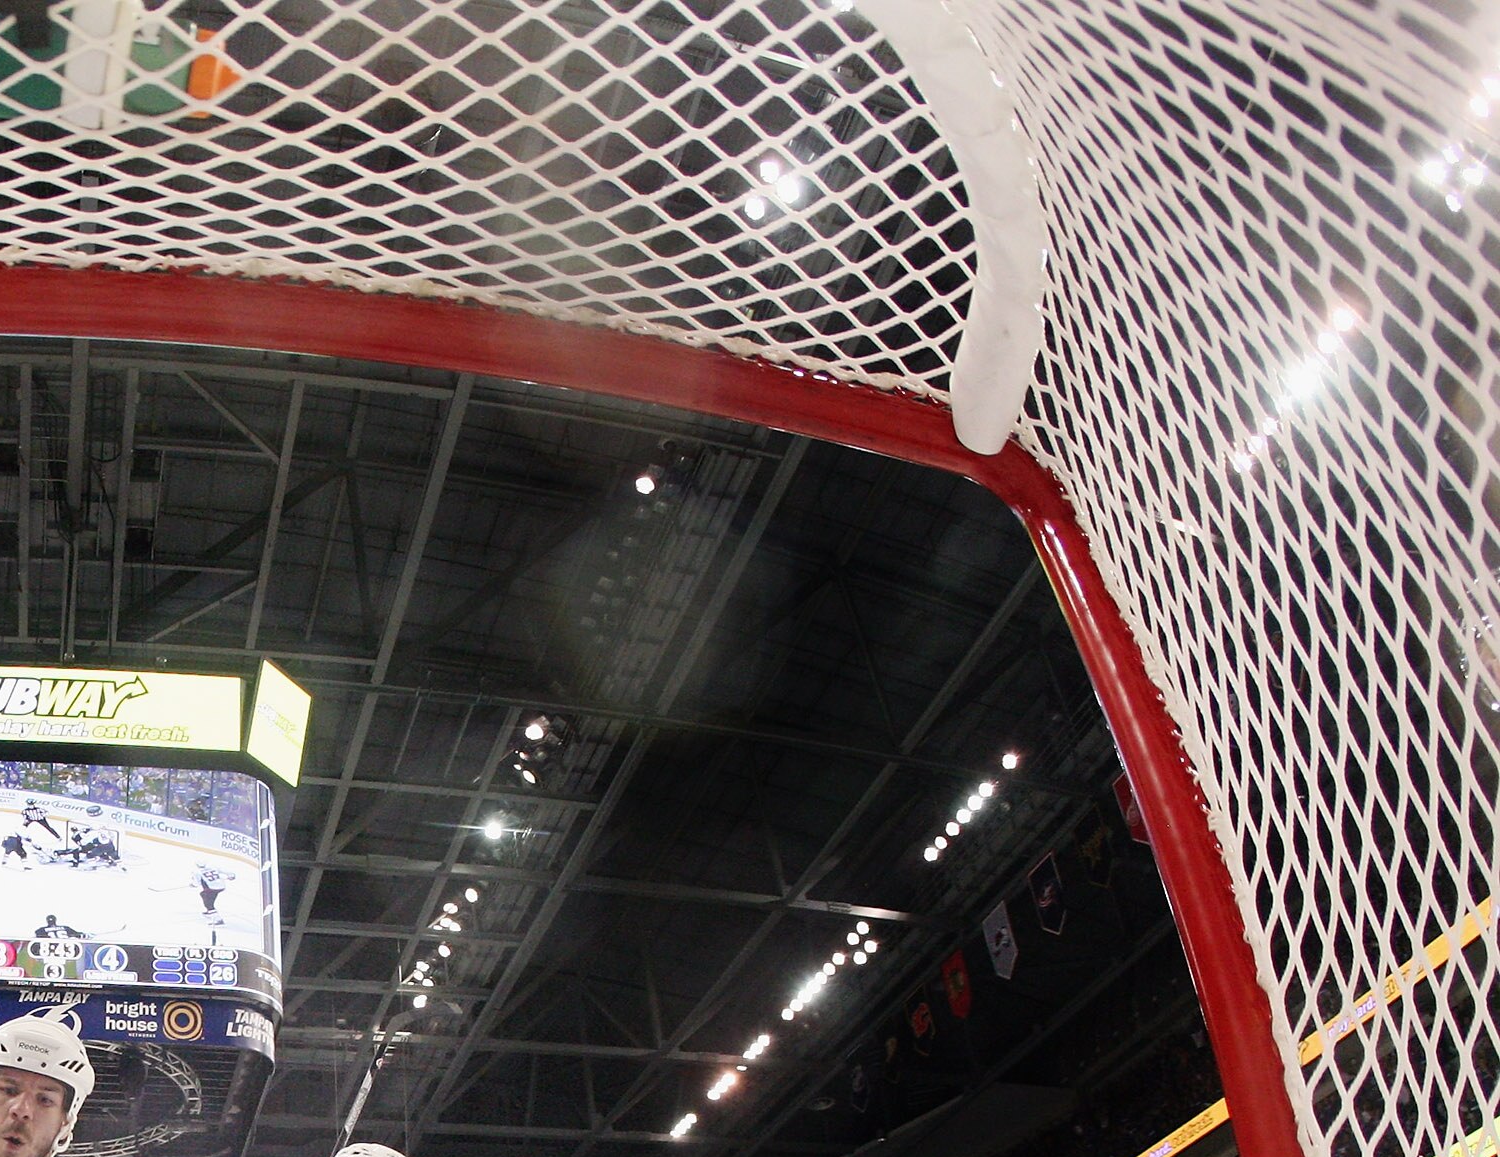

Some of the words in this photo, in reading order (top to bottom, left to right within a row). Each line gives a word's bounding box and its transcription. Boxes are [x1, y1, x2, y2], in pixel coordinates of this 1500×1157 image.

[37, 719, 88, 737] hard.
[92, 723, 127, 739] eat
[131, 725, 190, 742] fresh.
[222, 831, 248, 847] ROSE
[101, 948, 120, 970] 4
[211, 966, 234, 981] 26
[18, 990, 61, 1002] TAMPA
[62, 991, 90, 1004] BAY
[105, 1001, 157, 1017] bright
[105, 1017, 158, 1032] house
[18, 1041, 50, 1056] Reebok
